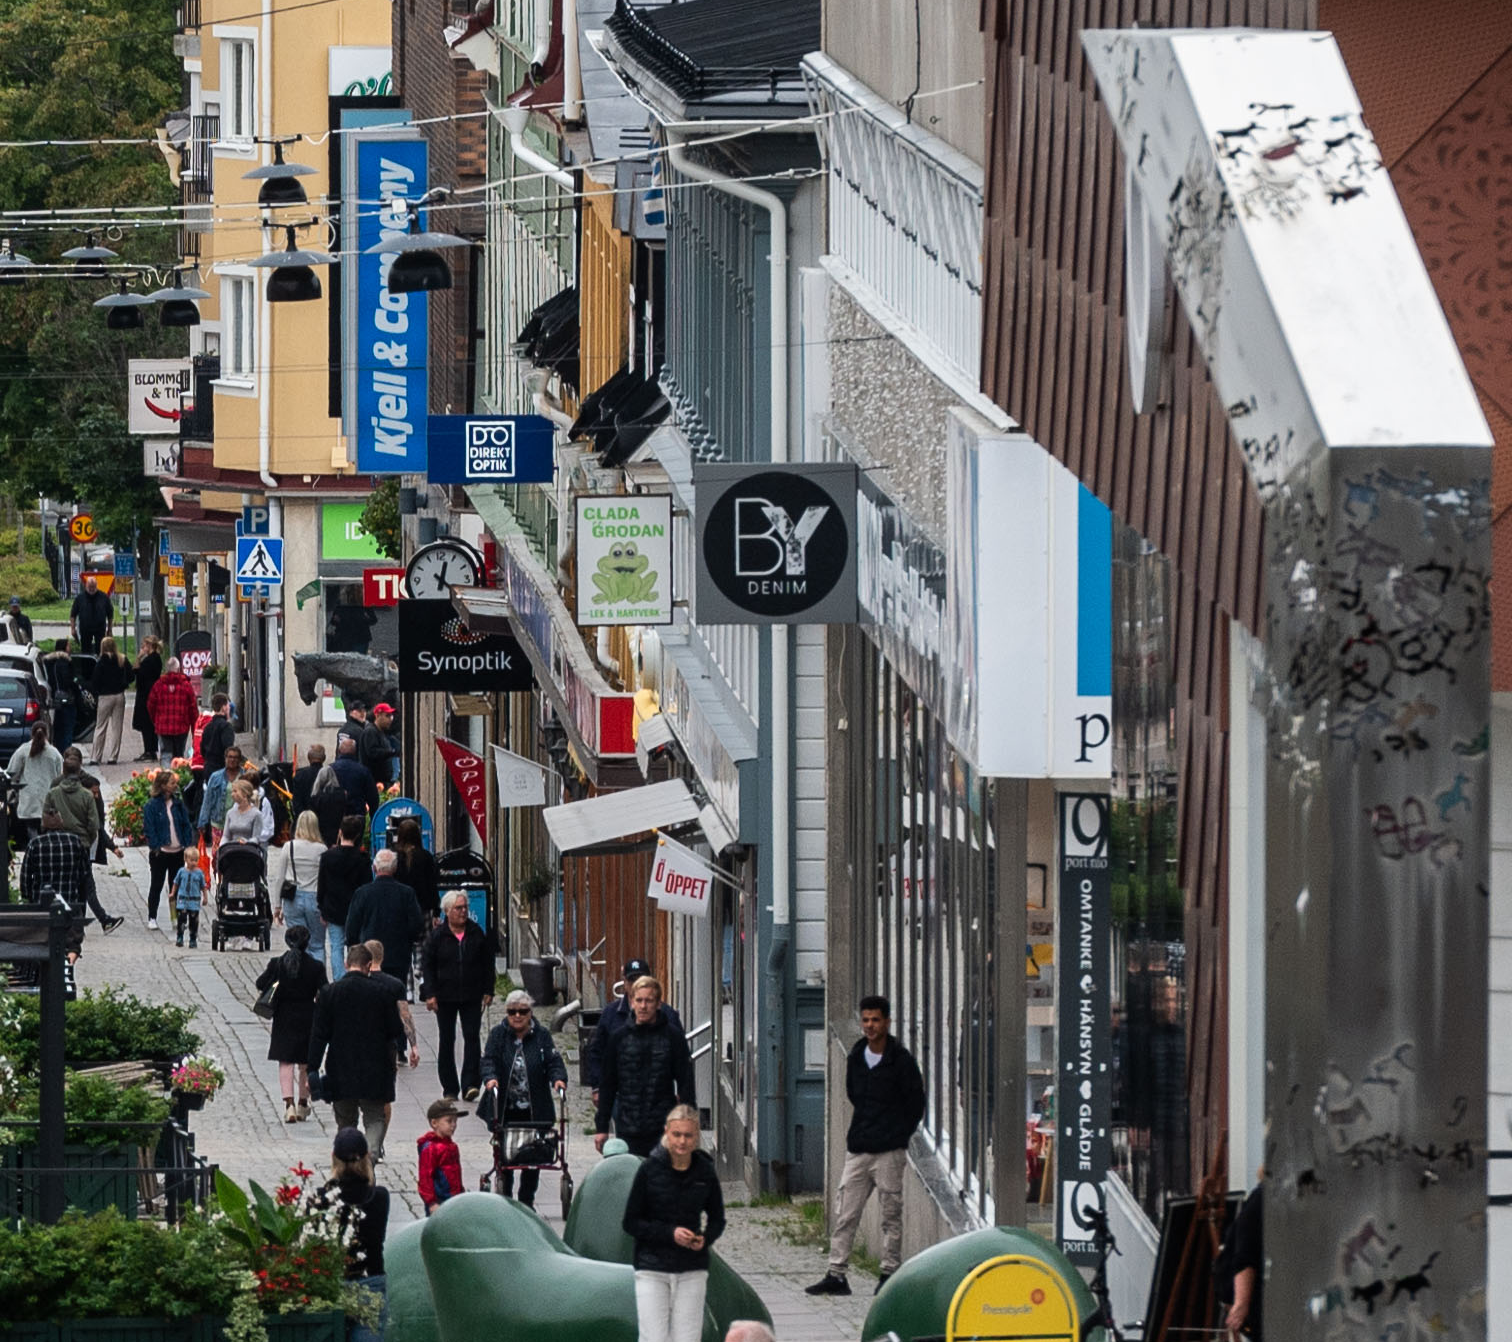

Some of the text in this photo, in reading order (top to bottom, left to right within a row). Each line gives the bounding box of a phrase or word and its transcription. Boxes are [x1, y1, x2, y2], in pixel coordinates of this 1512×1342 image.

[374, 344, 408, 368] &
[374, 367, 413, 458] Kjell
[469, 446, 512, 458] DIREKT
[472, 459, 509, 471] OPTIK
[250, 507, 268, 531] P
[592, 522, 665, 539] GRODAN
[735, 497, 830, 577] BY
[435, 550, 447, 561] 12
[413, 573, 471, 586] 9 3
[748, 580, 807, 596] DENIM
[589, 609, 605, 619] LEK
[182, 651, 212, 669] 60%
[418, 651, 512, 675] Synoptik
[664, 868, 708, 900] ÖPPET
[1079, 878, 1093, 970] OMTANKE
[1079, 999, 1096, 1075] HÄNSYN
[1078, 1103, 1095, 1171] GLÄDJE
